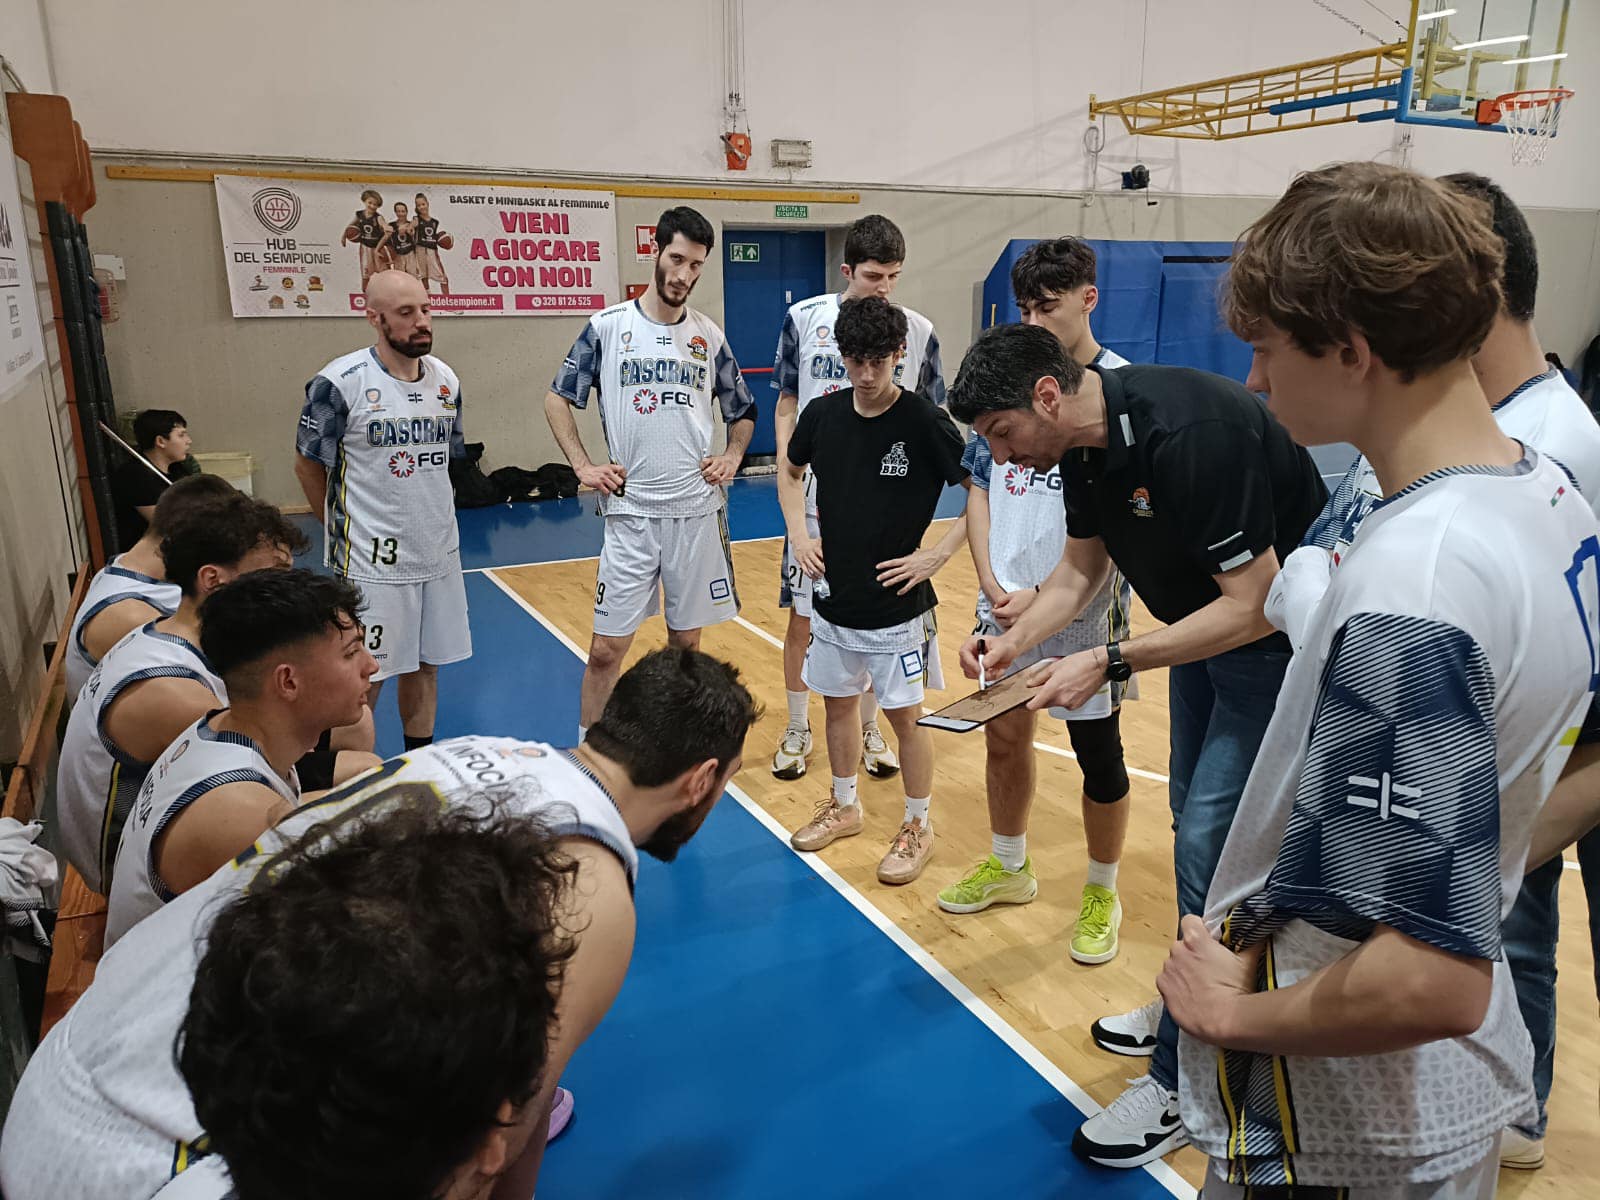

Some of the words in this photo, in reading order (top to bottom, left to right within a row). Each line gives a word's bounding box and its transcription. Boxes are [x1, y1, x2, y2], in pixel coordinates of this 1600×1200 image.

[449, 195, 486, 204] BASKET
[547, 199, 559, 207] AL
[499, 211, 570, 235] VIENI
[266, 238, 297, 251] HUB
[470, 238, 490, 260] A
[493, 239, 601, 262] GIOCARE
[234, 252, 260, 263] DEL
[263, 252, 332, 265] SEMPIONE
[263, 266, 307, 274] FEMMINILE
[482, 266, 535, 288] CON
[539, 266, 593, 288] NOI!
[430, 296, 497, 307] bdelsempione.it
[542, 296, 556, 306] 320
[558, 296, 566, 306] 81
[567, 297, 577, 306] 26
[578, 297, 592, 306] 525
[619, 358, 708, 392] CASORATE
[661, 391, 694, 409] FGL
[367, 416, 456, 448] CASORAT
[880, 464, 908, 476] BBG
[371, 536, 398, 566] 13
